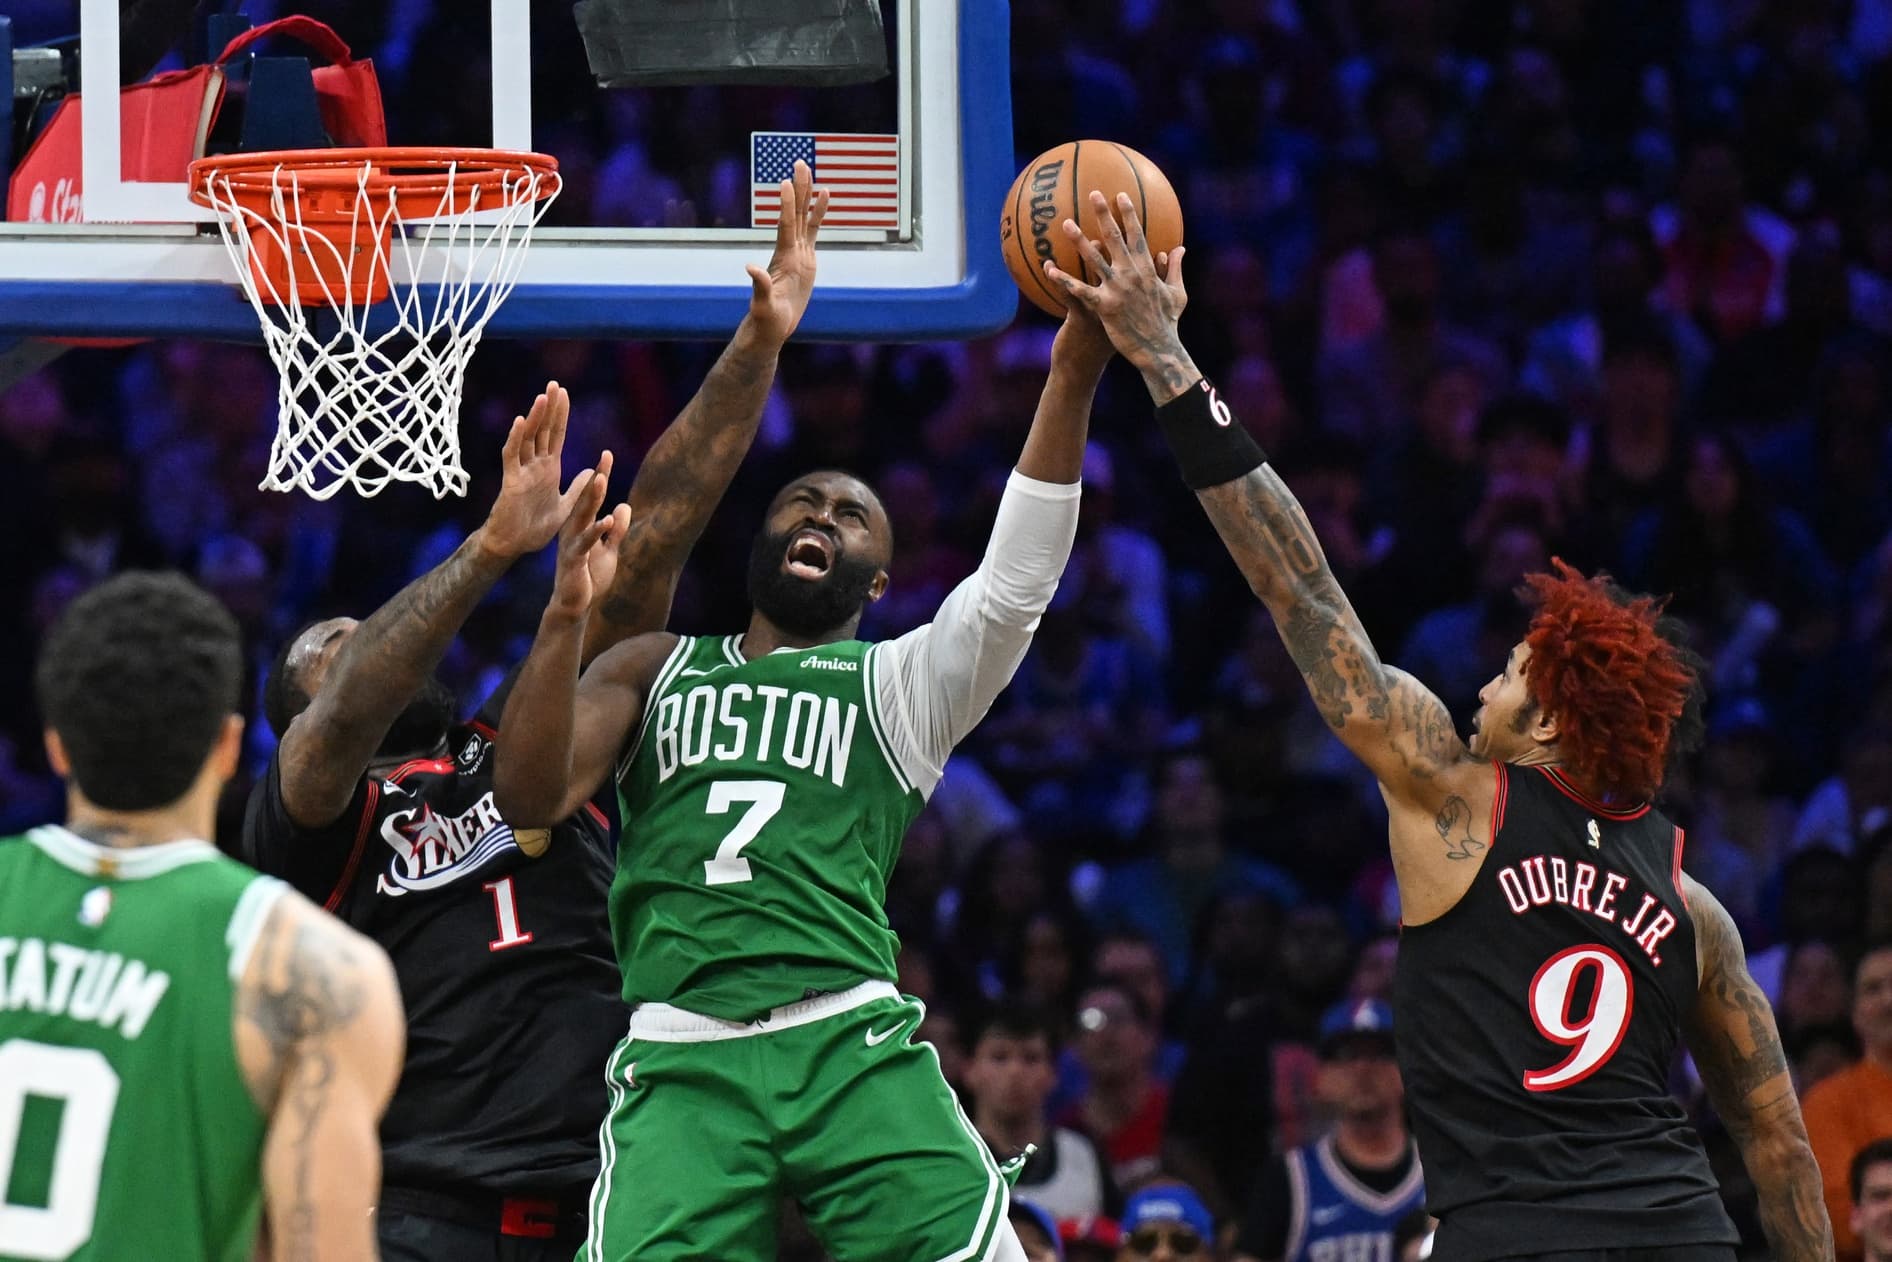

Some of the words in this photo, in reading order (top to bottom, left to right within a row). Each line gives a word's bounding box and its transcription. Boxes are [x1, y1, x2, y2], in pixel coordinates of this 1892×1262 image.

[800, 655, 858, 671] Amica
[656, 683, 859, 788] BOSTON
[376, 791, 503, 897] SIXER
[704, 780, 788, 886] 7
[482, 875, 534, 952] 1
[1497, 855, 1629, 923] OUBRE
[1621, 892, 1678, 968] JR.
[1522, 943, 1634, 1092] 9
[0, 1037, 121, 1262] 0
